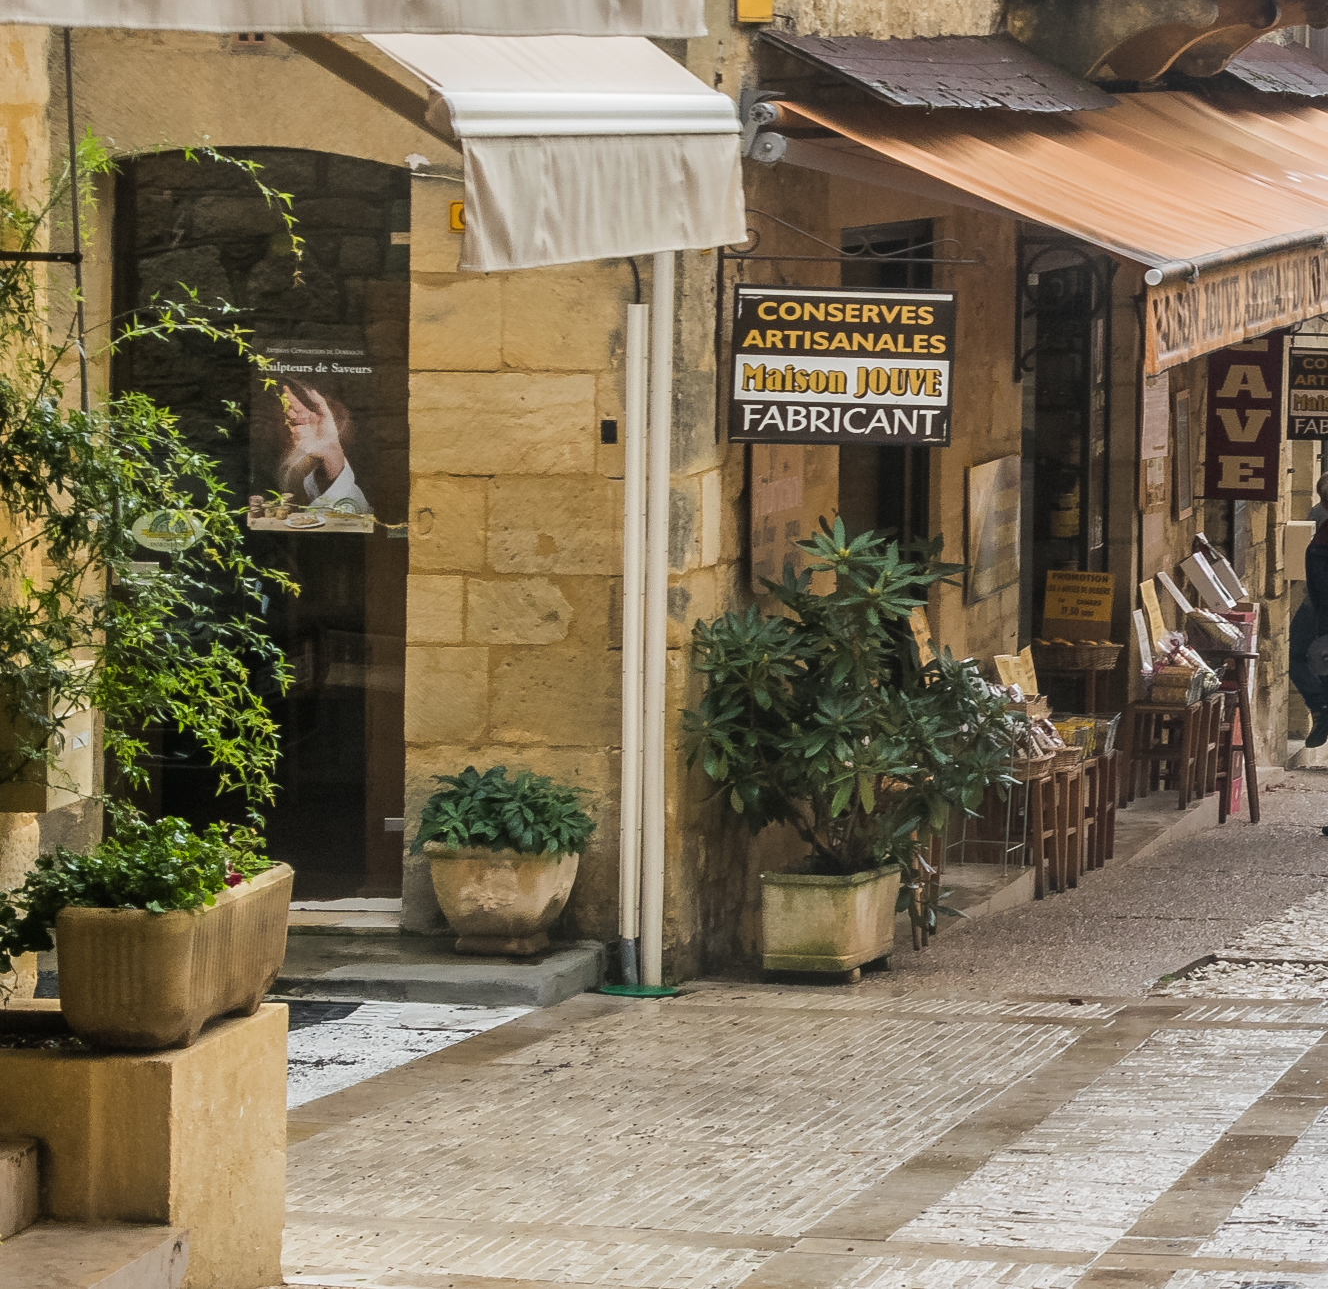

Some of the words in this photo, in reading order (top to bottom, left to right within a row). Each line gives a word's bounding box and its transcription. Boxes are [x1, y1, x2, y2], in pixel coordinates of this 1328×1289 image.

[757, 301, 935, 325] CONSERVES
[741, 329, 947, 354] ARTISANALES
[315, 362, 328, 373] de
[331, 362, 373, 374] Saveurs
[741, 363, 848, 395] Maison
[853, 366, 943, 399] JOUVE
[742, 404, 942, 436] FABRICANT
[1051, 572, 1109, 583] PROMOTION
